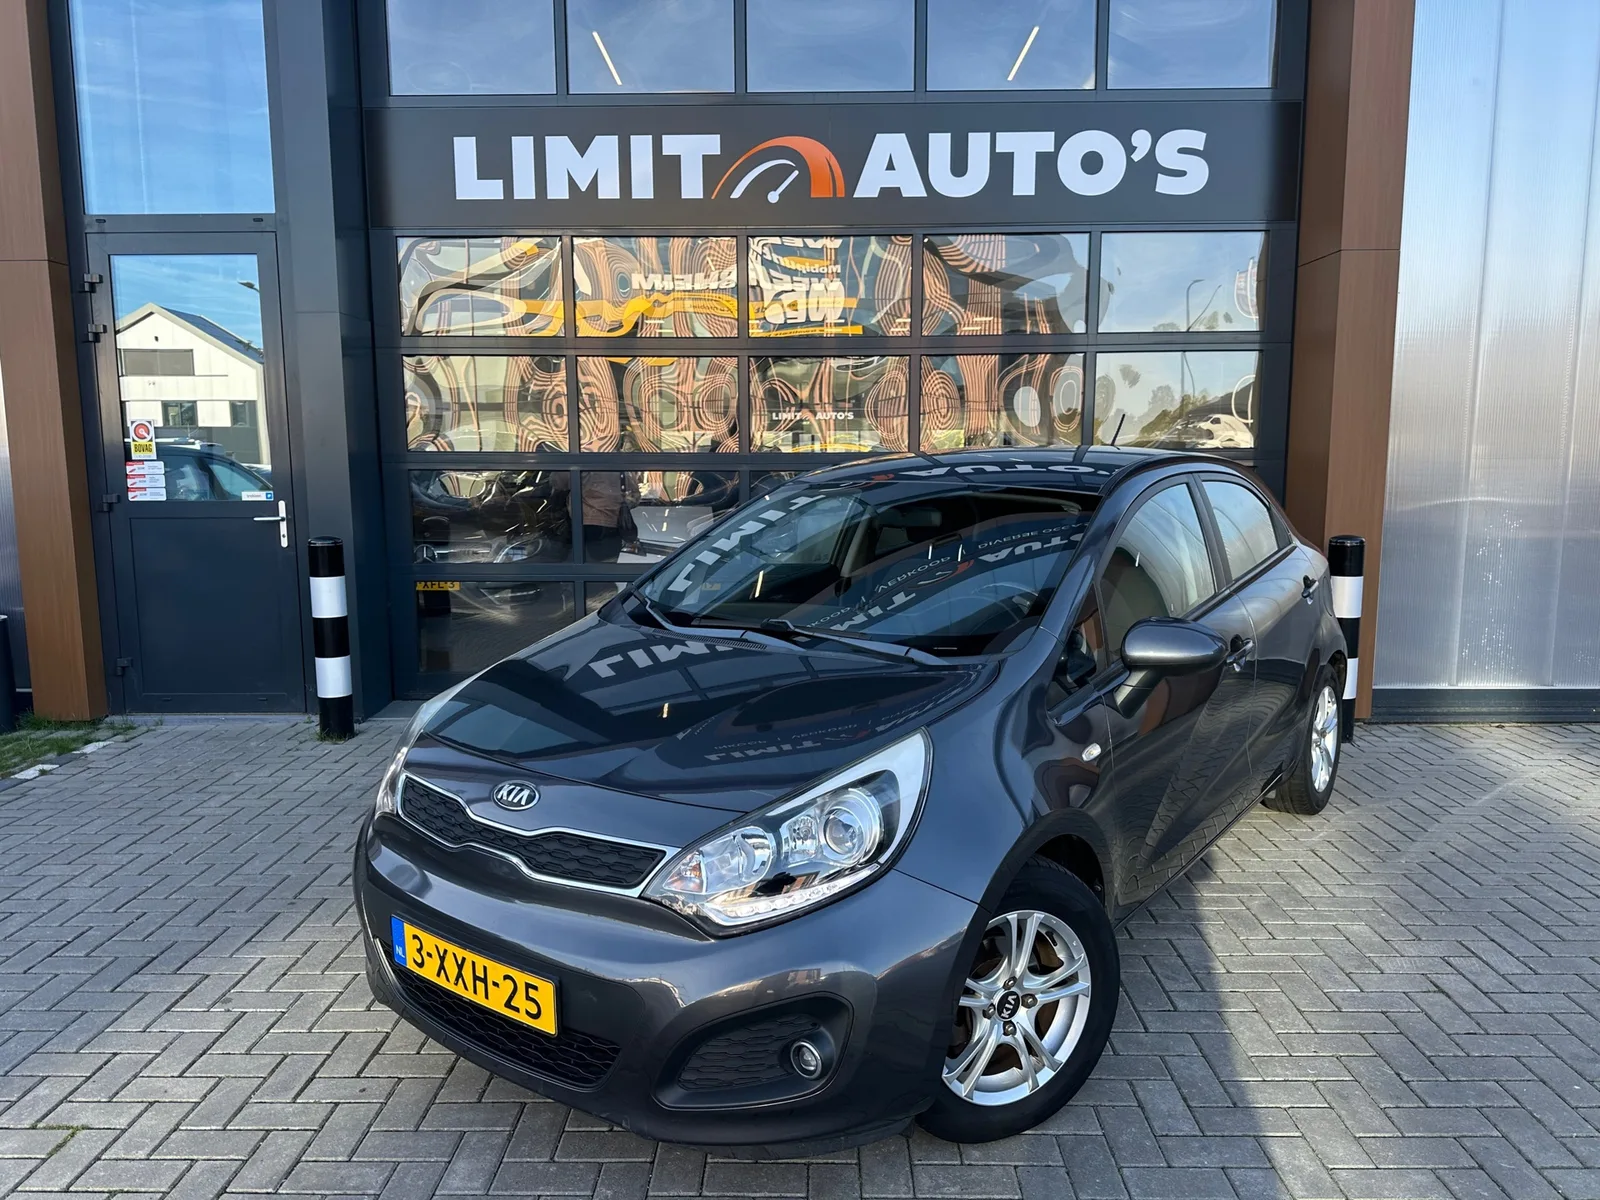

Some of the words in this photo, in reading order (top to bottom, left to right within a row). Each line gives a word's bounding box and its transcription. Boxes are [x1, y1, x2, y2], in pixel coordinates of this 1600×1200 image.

[454, 135, 720, 199] LIMIT
[853, 130, 1208, 197] AUTO'S
[771, 412, 803, 421] LIMIT
[815, 411, 855, 420] AUTO'S
[134, 444, 153, 453] BOVAG
[496, 784, 531, 806] KIA
[394, 946, 405, 959] NL
[412, 933, 542, 1020] 3-XXH-25
[1000, 994, 1018, 1018] KIA
